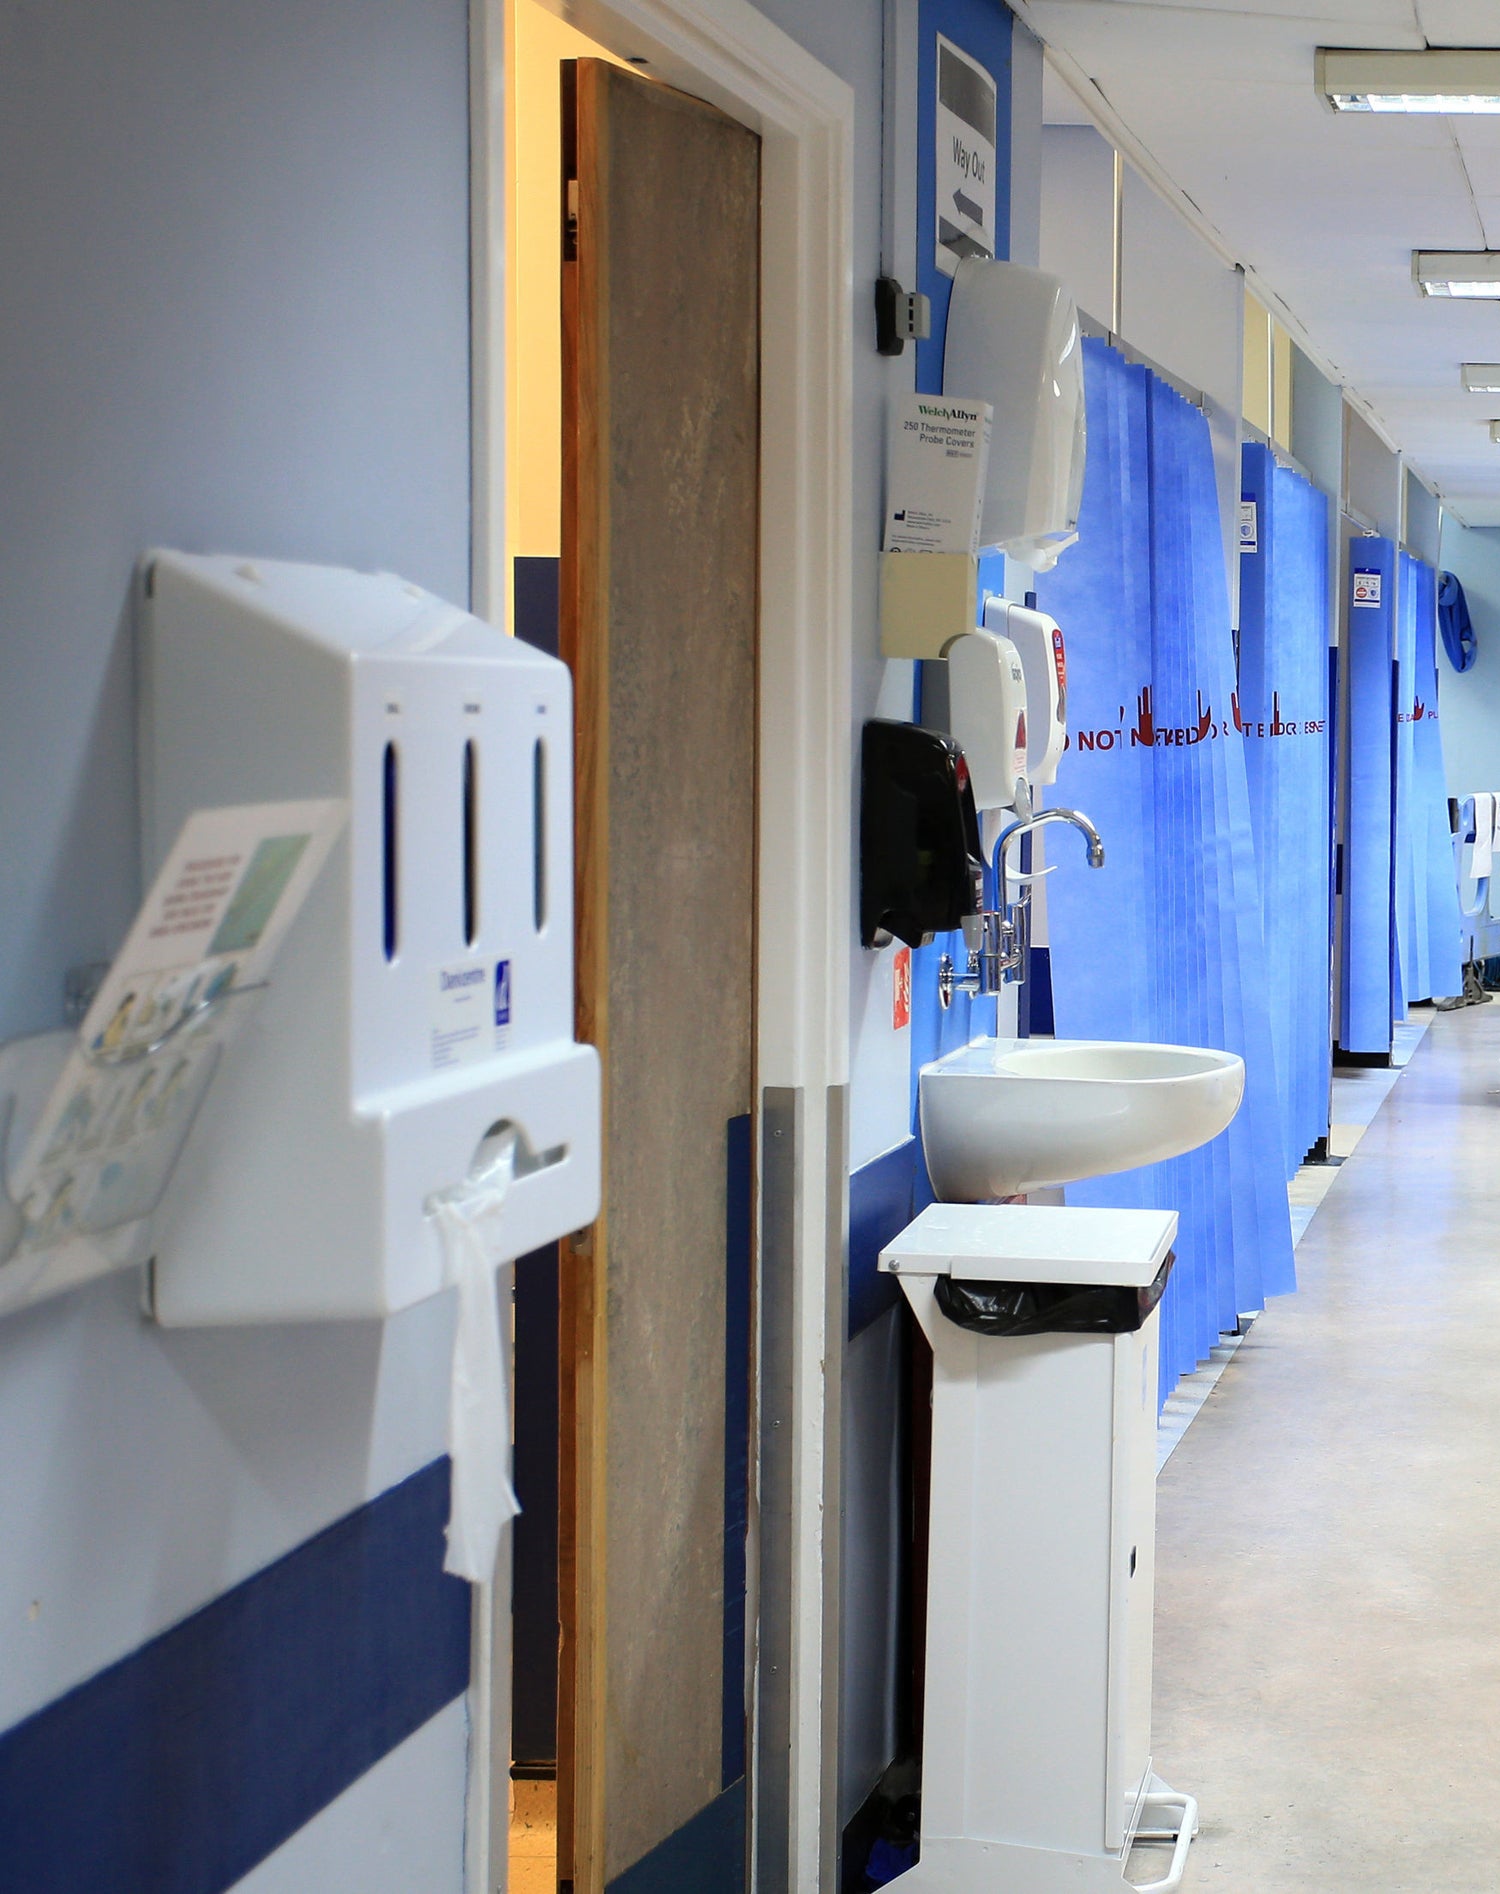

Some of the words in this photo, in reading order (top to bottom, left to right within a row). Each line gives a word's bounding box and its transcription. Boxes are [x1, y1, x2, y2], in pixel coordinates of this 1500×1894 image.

[953, 136, 971, 179] Way
[972, 151, 986, 184] Out
[904, 421, 918, 431] 250
[921, 422, 975, 437] Thermometer
[920, 433, 944, 444] Probe
[946, 437, 974, 448] Covers
